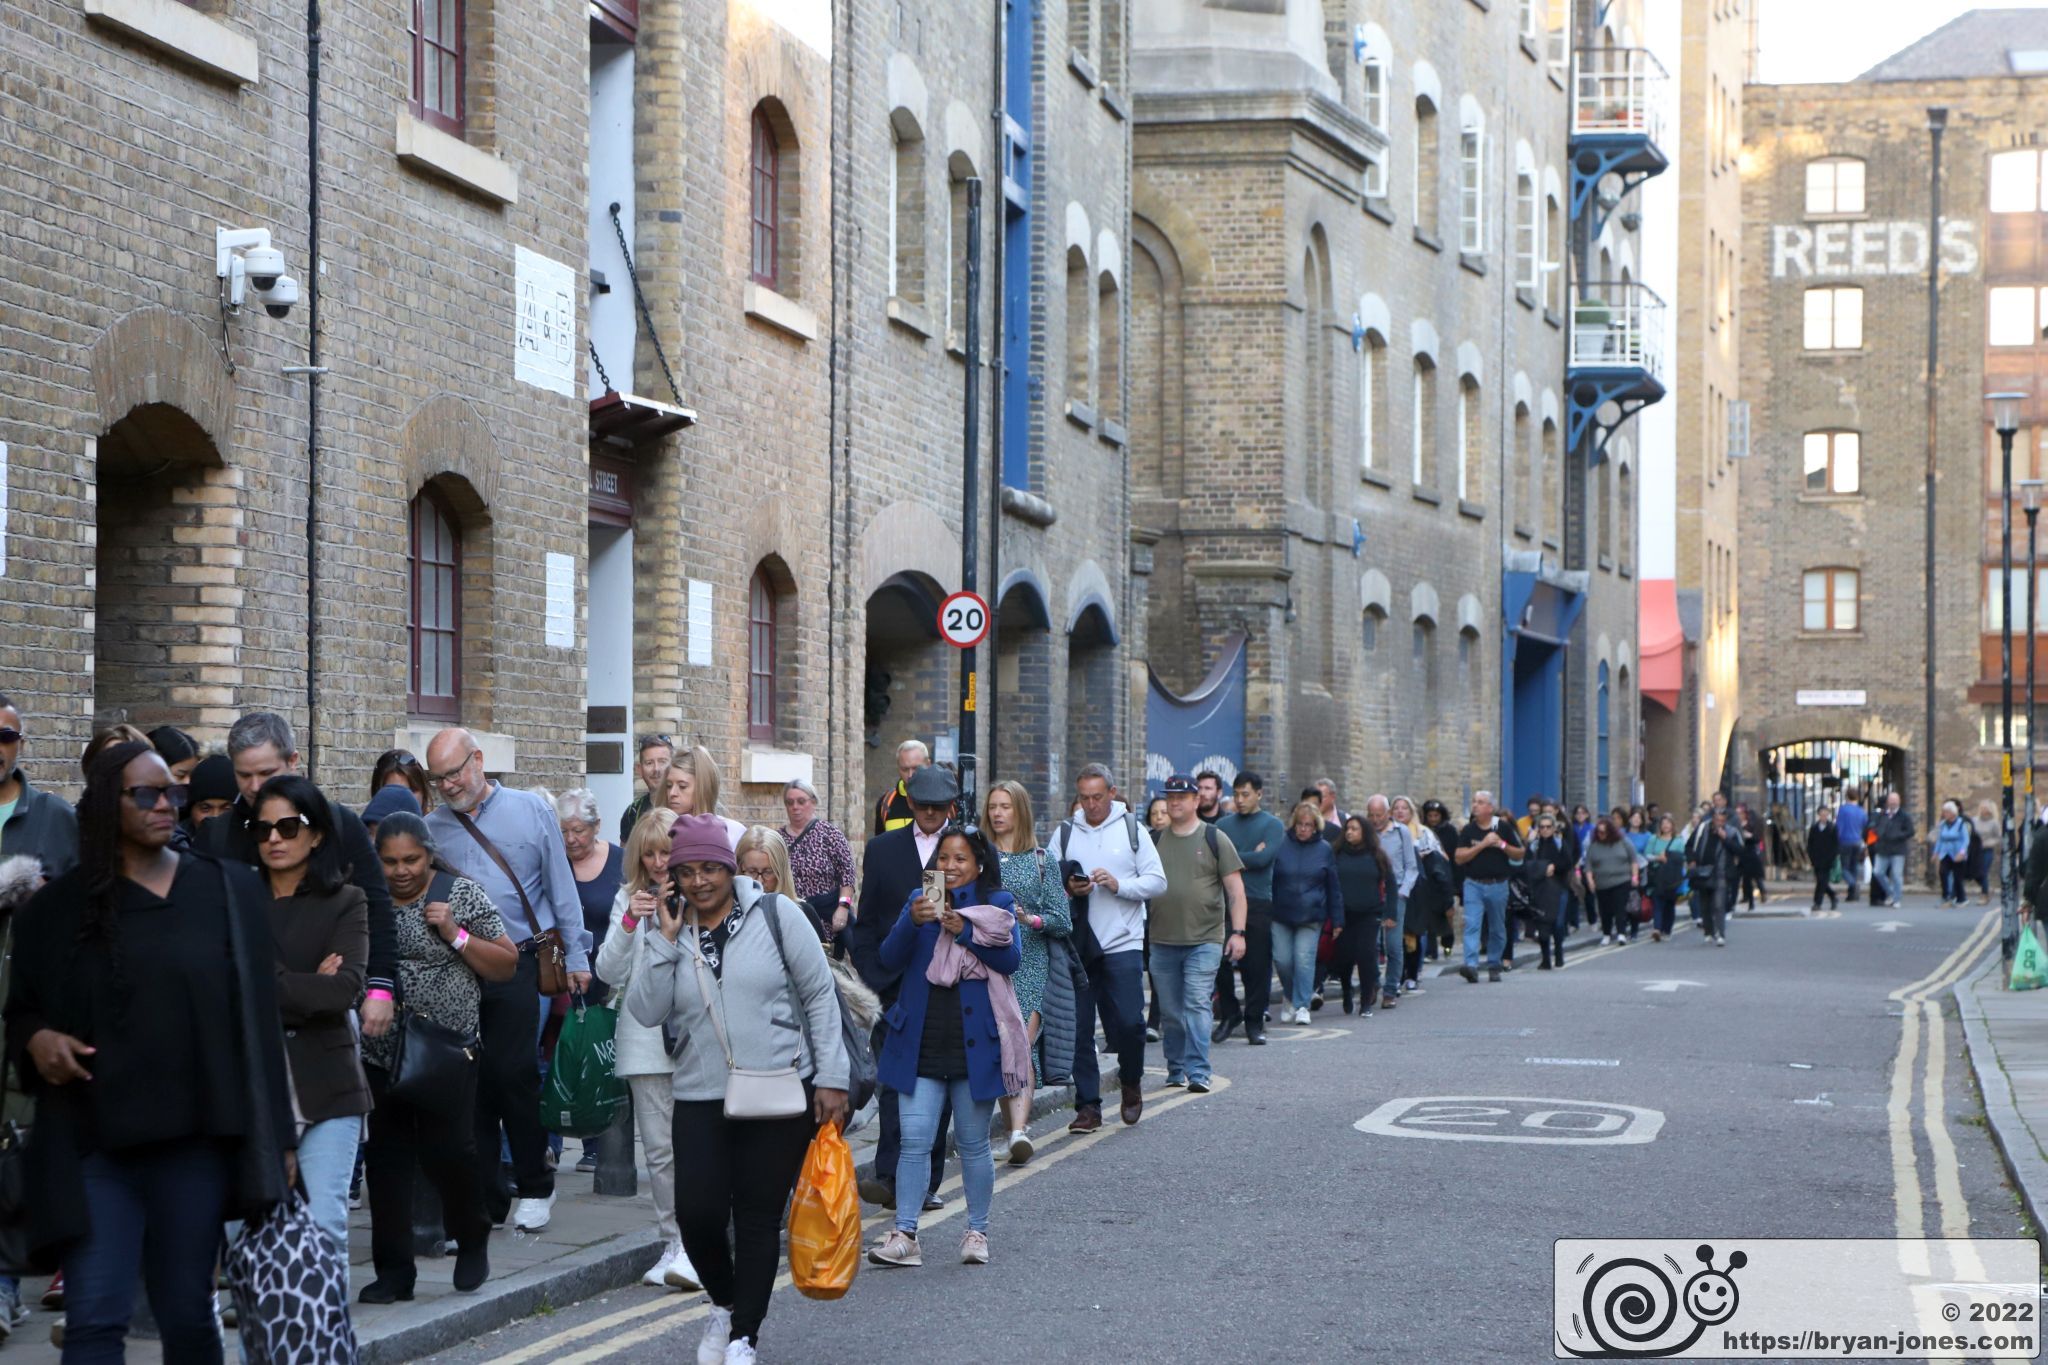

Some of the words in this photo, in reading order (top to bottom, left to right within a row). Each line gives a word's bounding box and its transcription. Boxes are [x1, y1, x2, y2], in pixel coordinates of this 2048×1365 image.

[595, 469, 618, 494] STREET
[947, 608, 983, 631] 20
[593, 1038, 617, 1066] M&
[1400, 1106, 1627, 1132] 20
